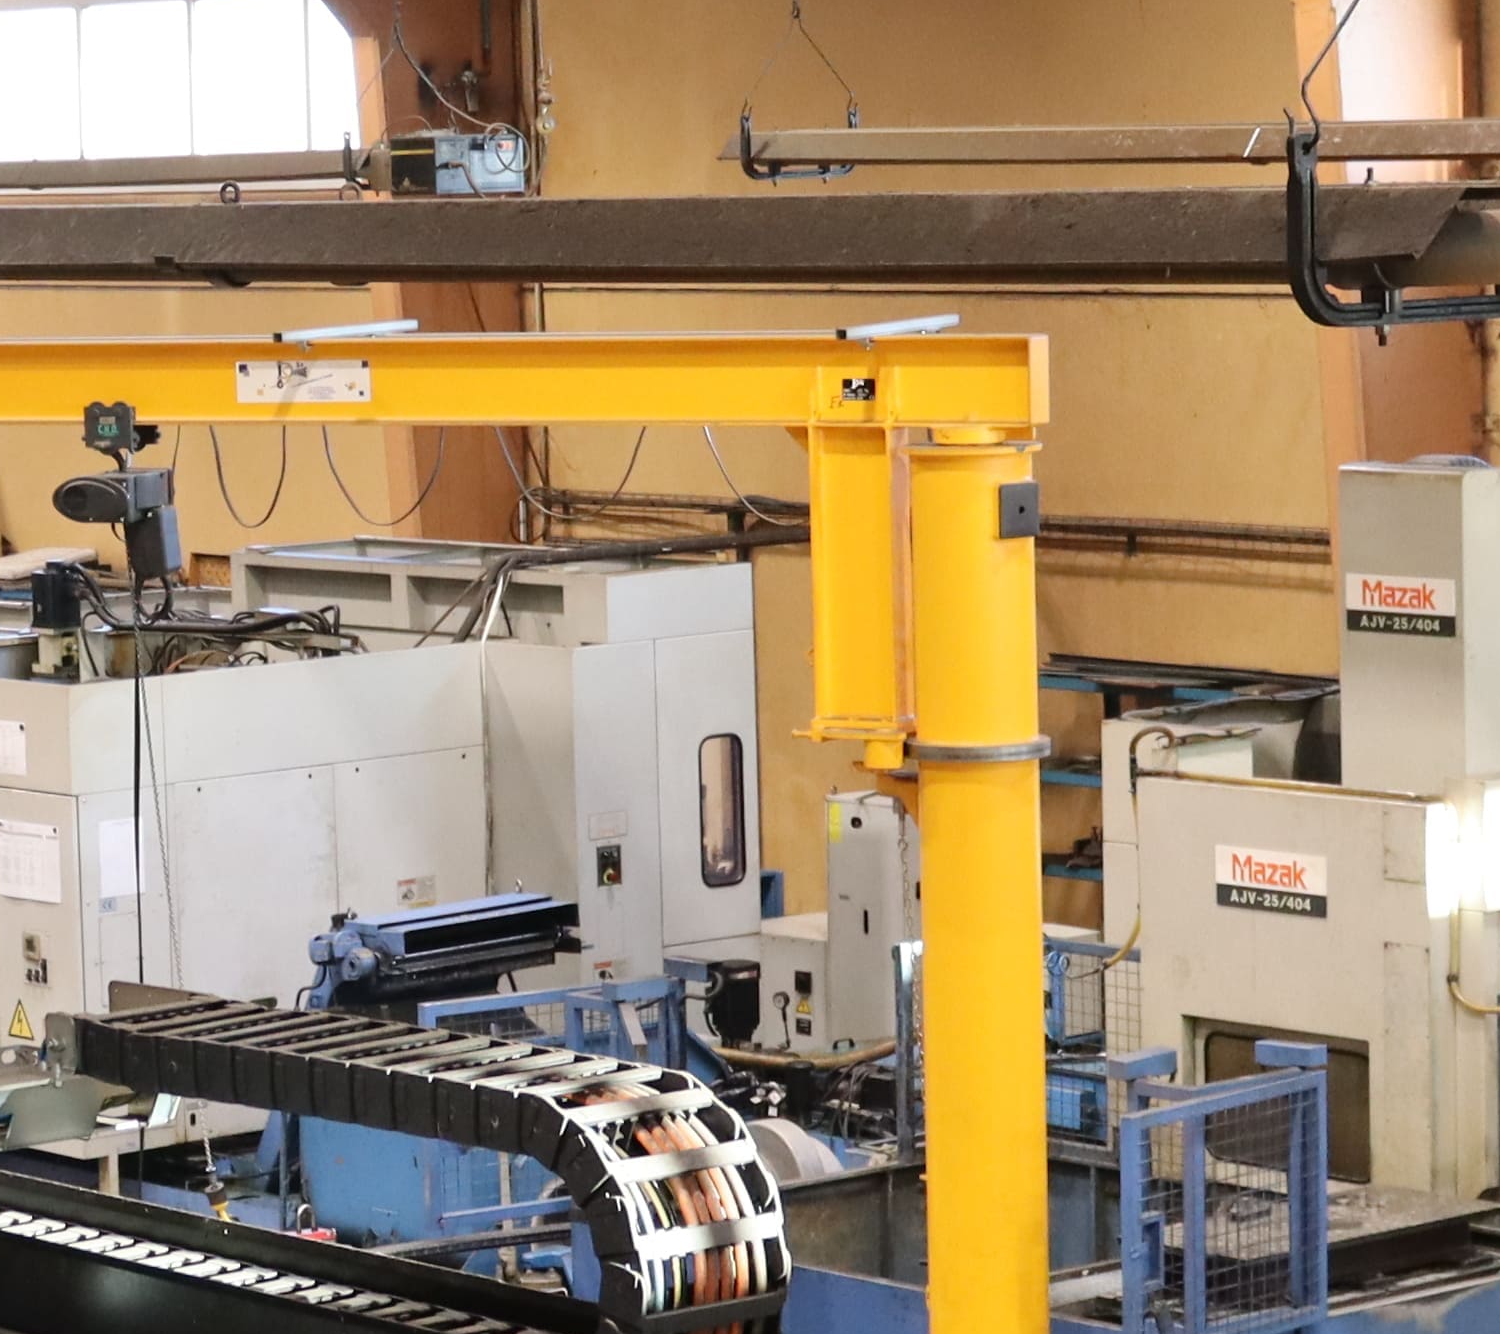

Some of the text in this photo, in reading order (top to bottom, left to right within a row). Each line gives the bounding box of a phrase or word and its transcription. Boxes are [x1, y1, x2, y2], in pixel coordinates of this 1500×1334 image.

[1361, 578, 1437, 611] Mazak
[1359, 614, 1441, 633] AJV-25/404
[1231, 851, 1308, 891] Mazak
[1229, 888, 1312, 912] AJV-25/404
